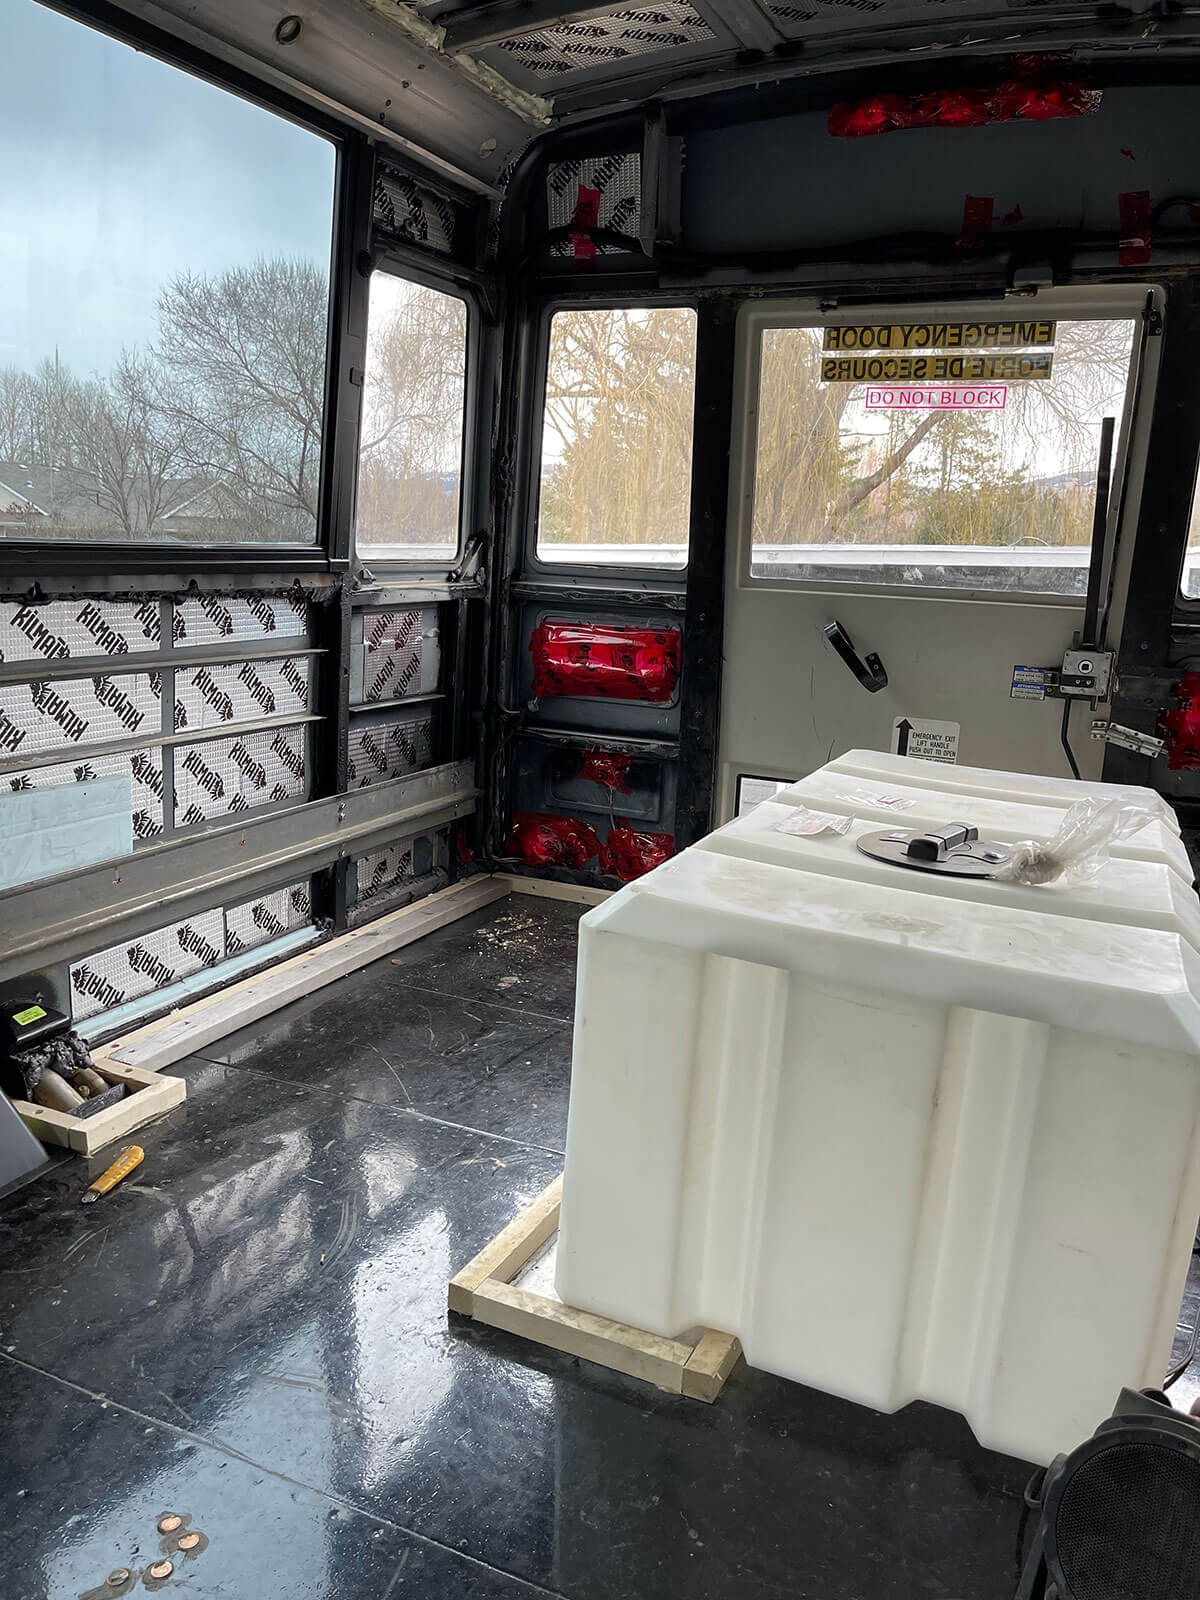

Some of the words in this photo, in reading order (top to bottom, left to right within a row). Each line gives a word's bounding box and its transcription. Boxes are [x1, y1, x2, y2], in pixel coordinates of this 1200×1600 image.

[870, 391, 895, 405] DO
[899, 391, 935, 405] NOT
[940, 390, 1001, 405] BLOCK
[912, 731, 942, 741] EMERGENCY
[945, 735, 955, 743] EXIT
